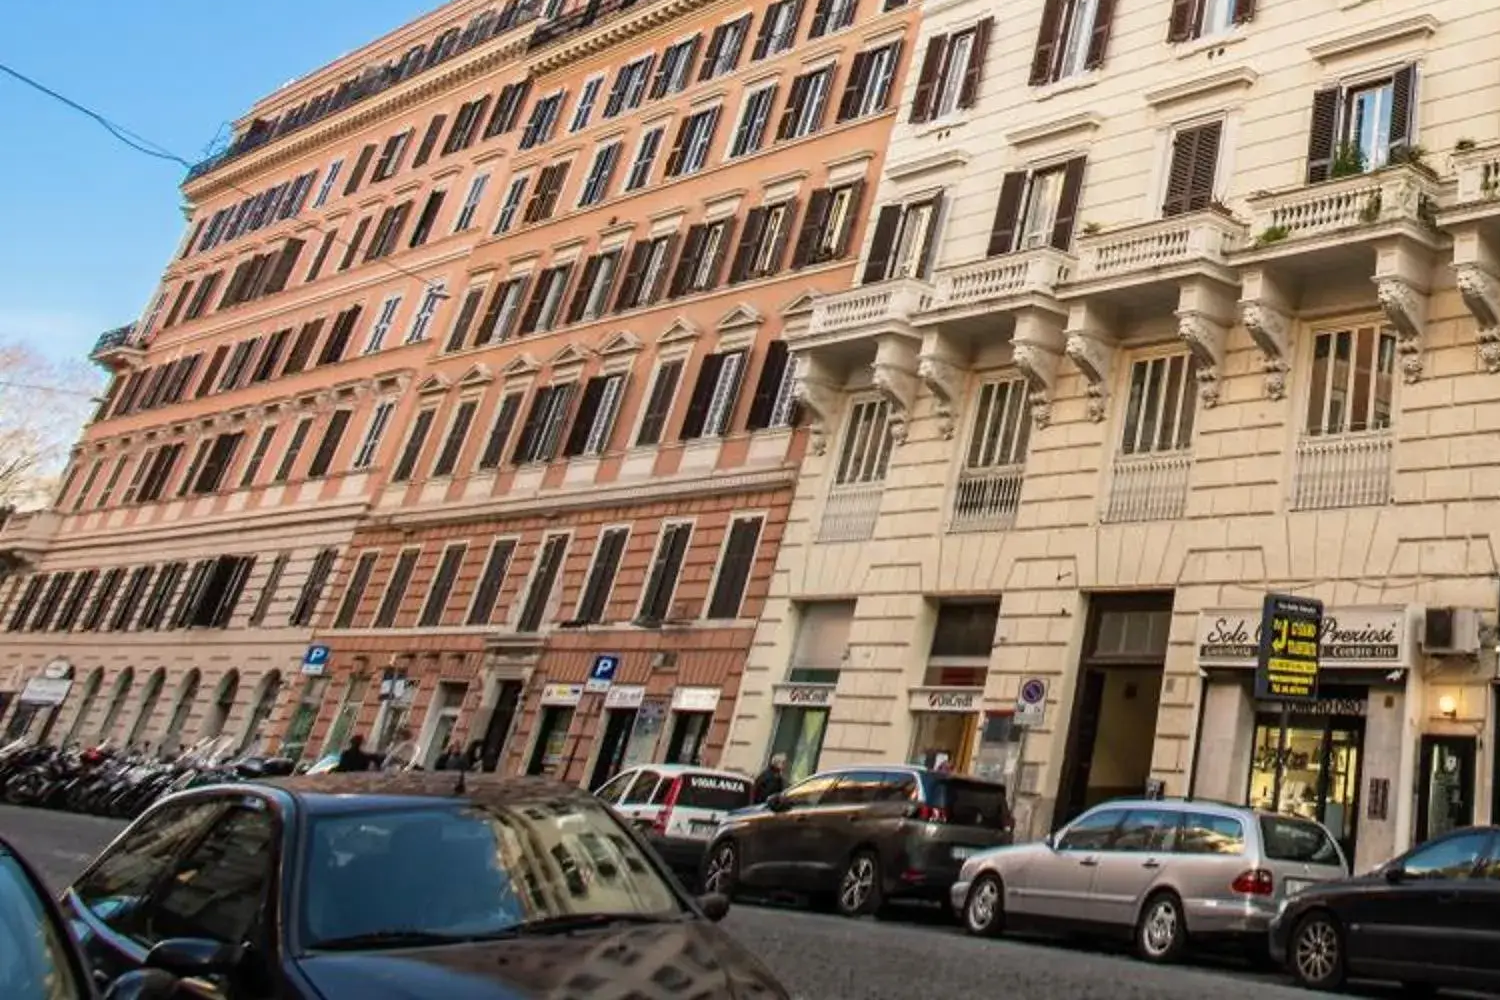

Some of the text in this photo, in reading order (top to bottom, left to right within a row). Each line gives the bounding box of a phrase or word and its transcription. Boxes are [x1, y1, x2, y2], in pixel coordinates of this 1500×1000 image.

[1207, 617, 1249, 643] Solo
[1321, 616, 1397, 643] Preziosi
[310, 648, 325, 662] P
[596, 659, 612, 676] P
[691, 777, 745, 792] VIGILANZA
